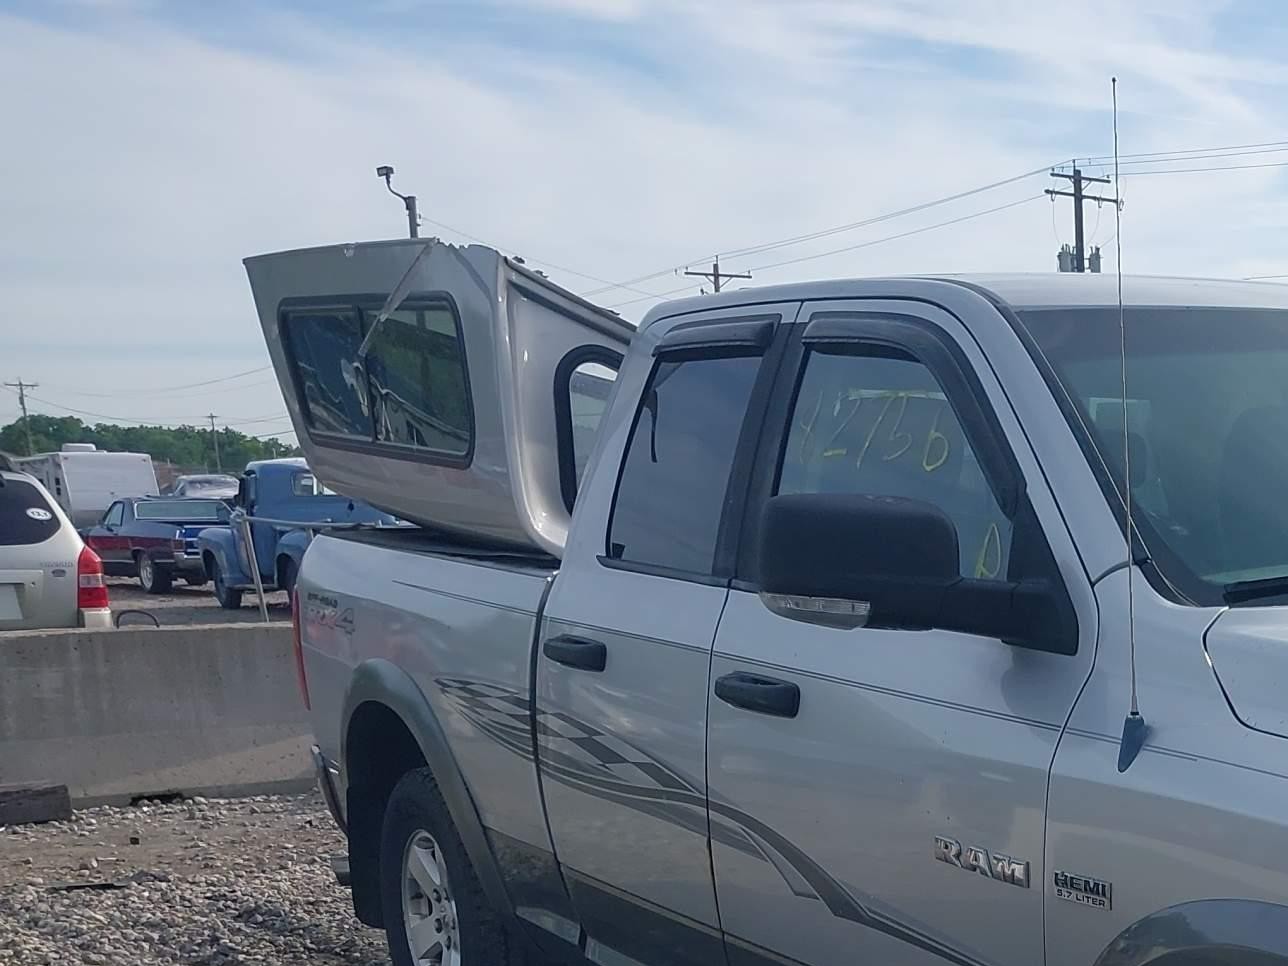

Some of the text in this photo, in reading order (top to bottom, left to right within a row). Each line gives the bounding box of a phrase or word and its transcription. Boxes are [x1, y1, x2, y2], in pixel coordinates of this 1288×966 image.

[935, 835, 1030, 888] RAM
[1054, 870, 1108, 898] HEMI
[1056, 888, 1106, 908] 5.7 LITER
